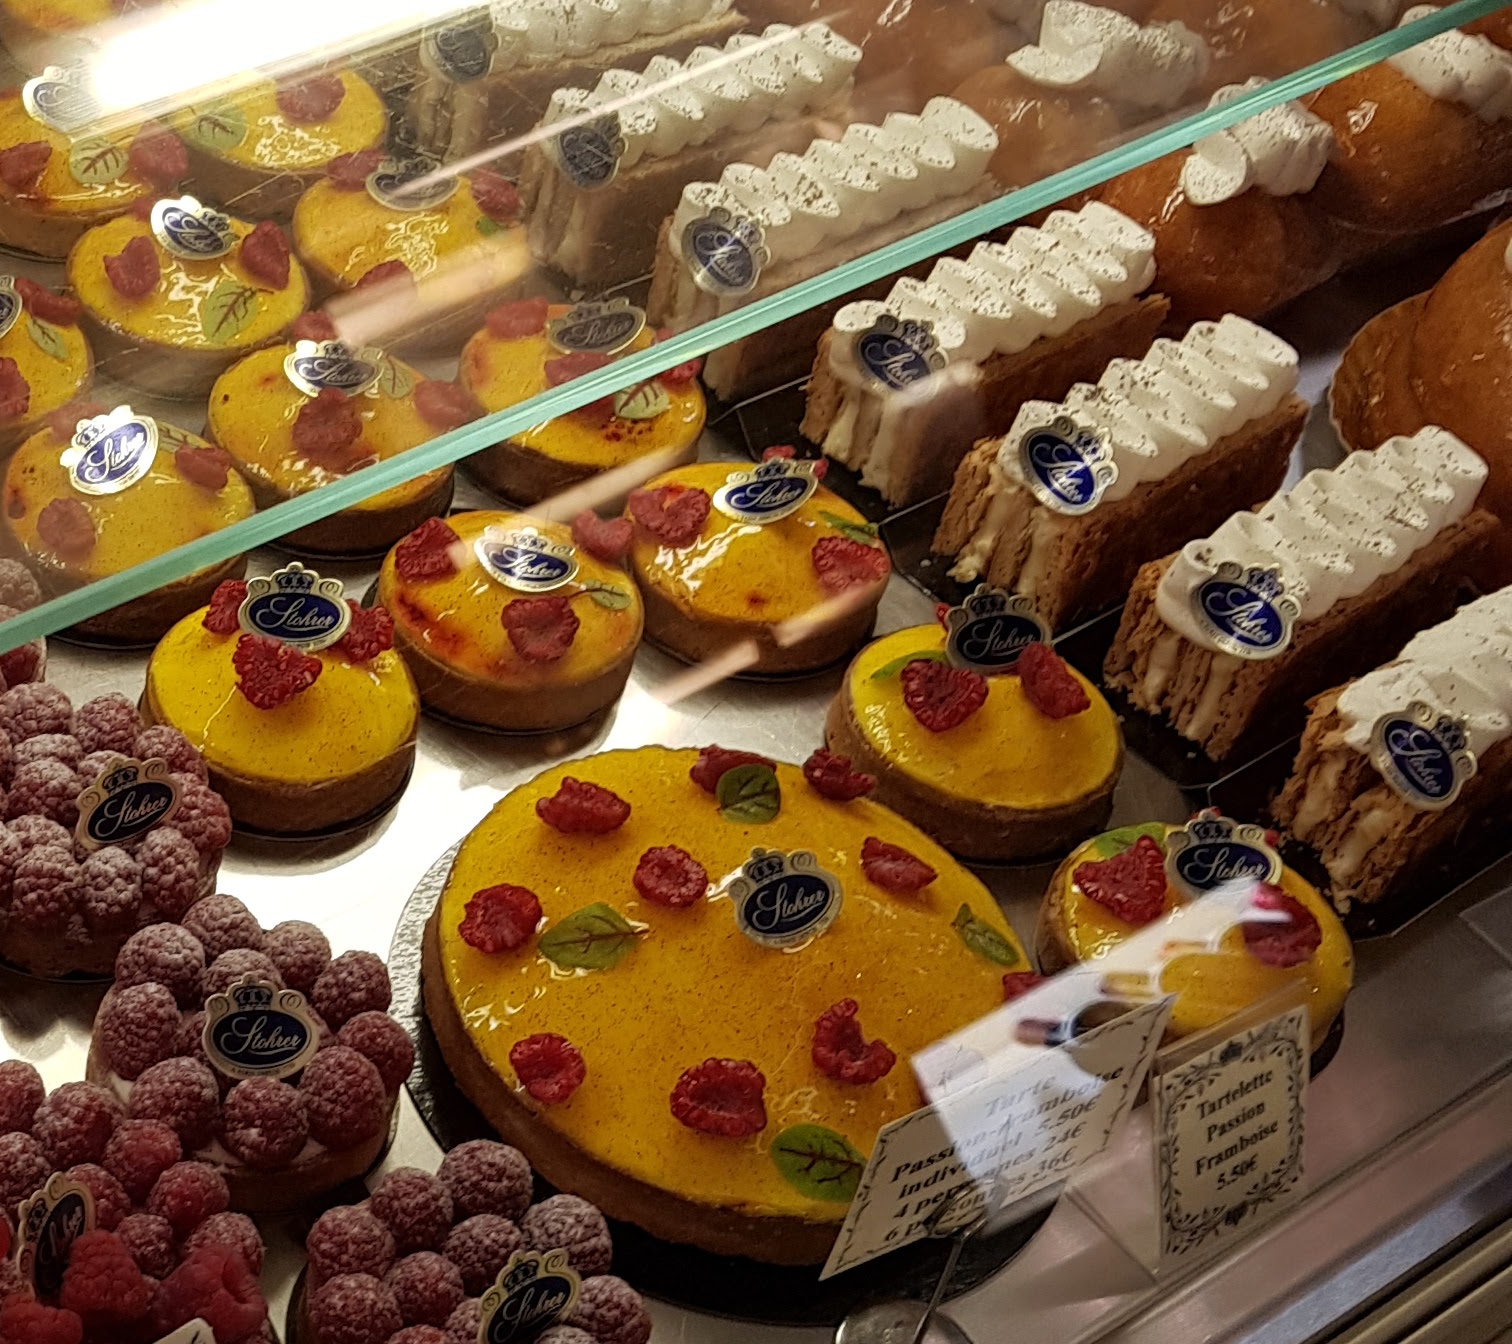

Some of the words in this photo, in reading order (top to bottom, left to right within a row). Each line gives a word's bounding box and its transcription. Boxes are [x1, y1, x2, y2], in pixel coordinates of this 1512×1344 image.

[255, 596, 335, 632] Stohrer
[963, 618, 1036, 659] Stohrer
[96, 791, 168, 838] Stohrer
[750, 881, 826, 931] Stohrer
[219, 1015, 302, 1056] Stohrer
[1196, 1069, 1273, 1120] Tartelette
[1206, 1102, 1265, 1144] Passion
[1194, 1119, 1278, 1177] Framboise
